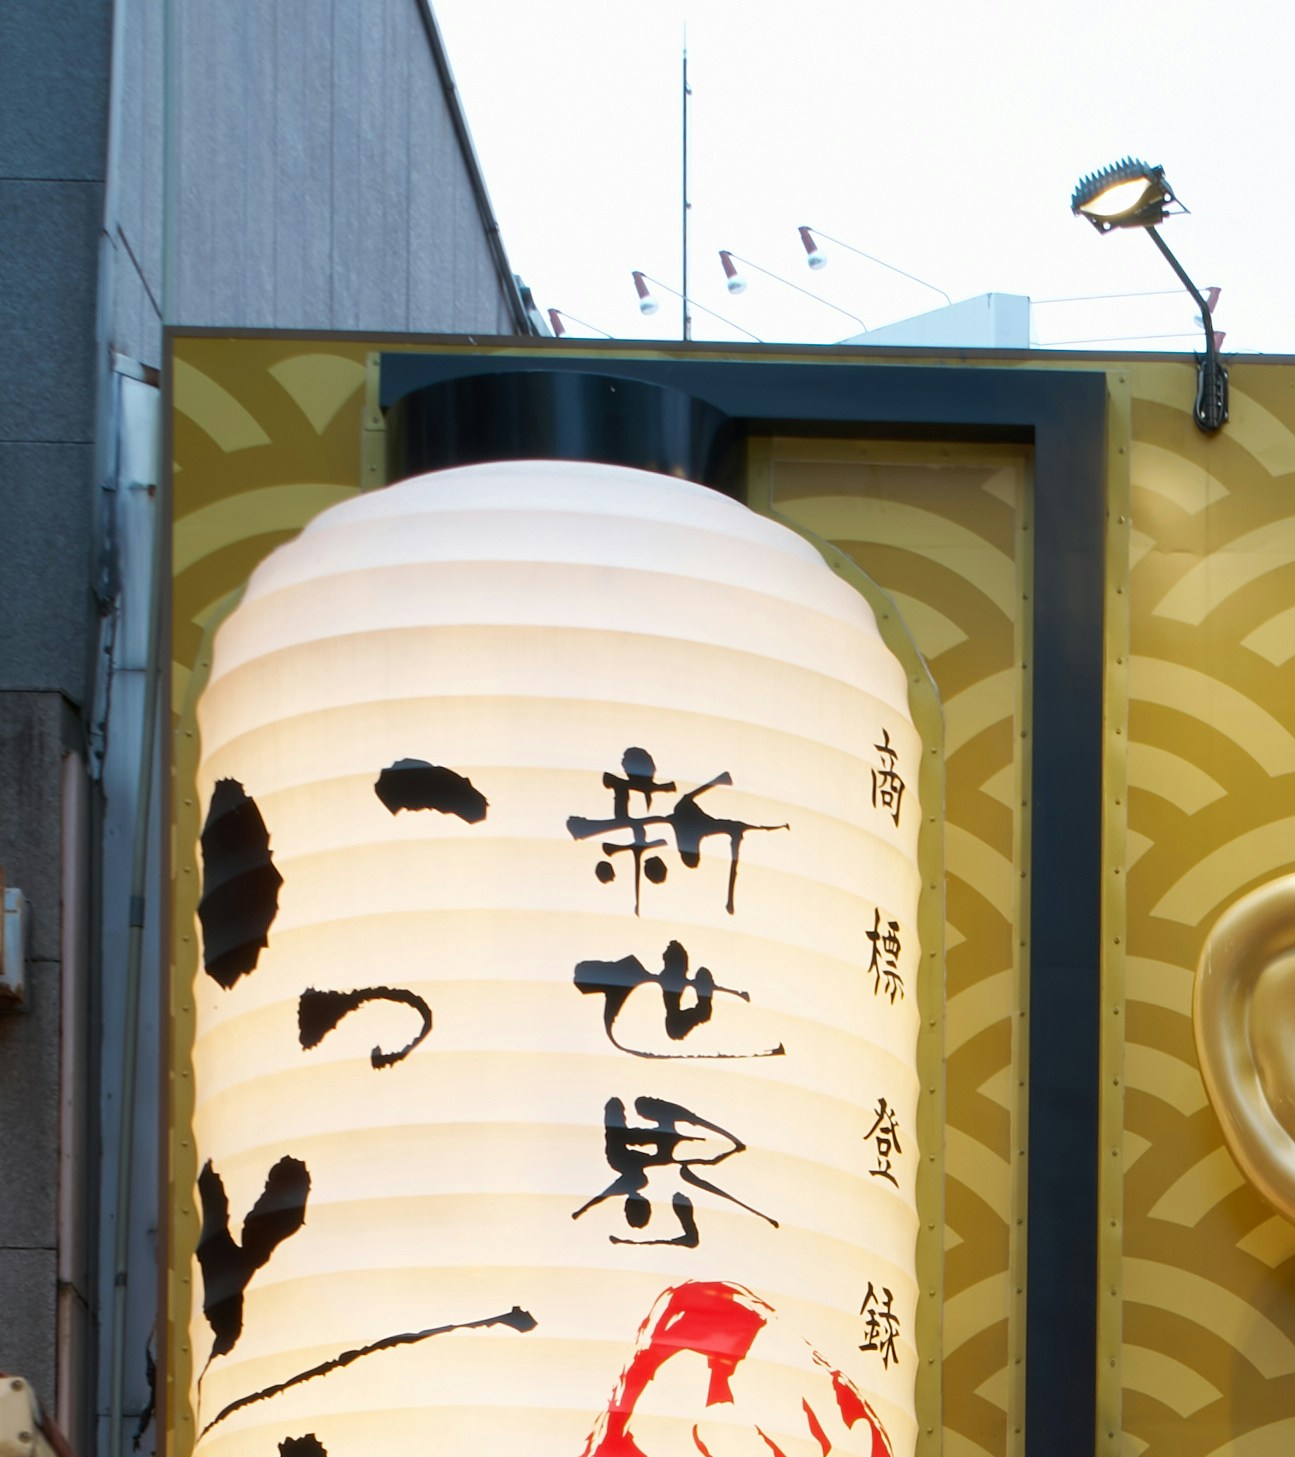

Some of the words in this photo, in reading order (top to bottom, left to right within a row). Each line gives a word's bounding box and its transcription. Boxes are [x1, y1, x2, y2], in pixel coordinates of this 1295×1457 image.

[568, 745, 790, 1247] 新世界
[862, 726, 907, 1372] 商標登録
